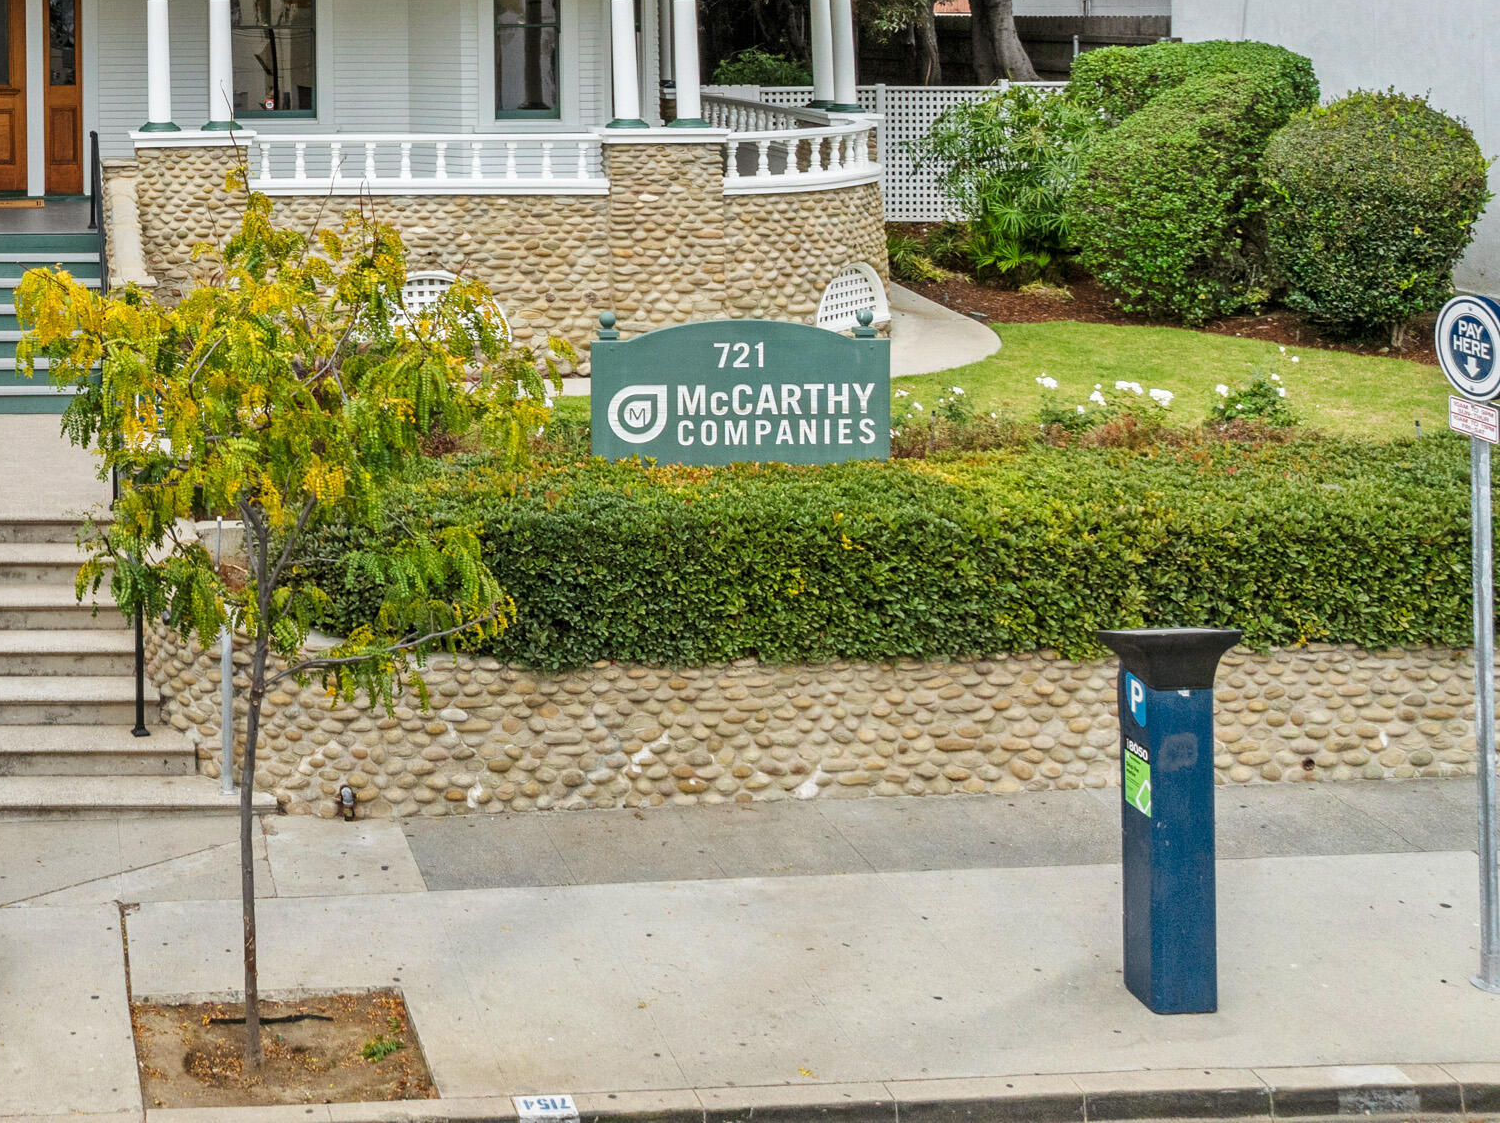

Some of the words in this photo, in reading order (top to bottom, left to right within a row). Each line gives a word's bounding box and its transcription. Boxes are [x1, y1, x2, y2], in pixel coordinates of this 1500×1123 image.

[1458, 319, 1484, 339] PAY
[713, 341, 765, 369] 721
[1453, 334, 1491, 360] HERE
[676, 382, 875, 416] McCARTHY
[676, 418, 876, 446] COMPANIES
[1130, 679, 1145, 713] P
